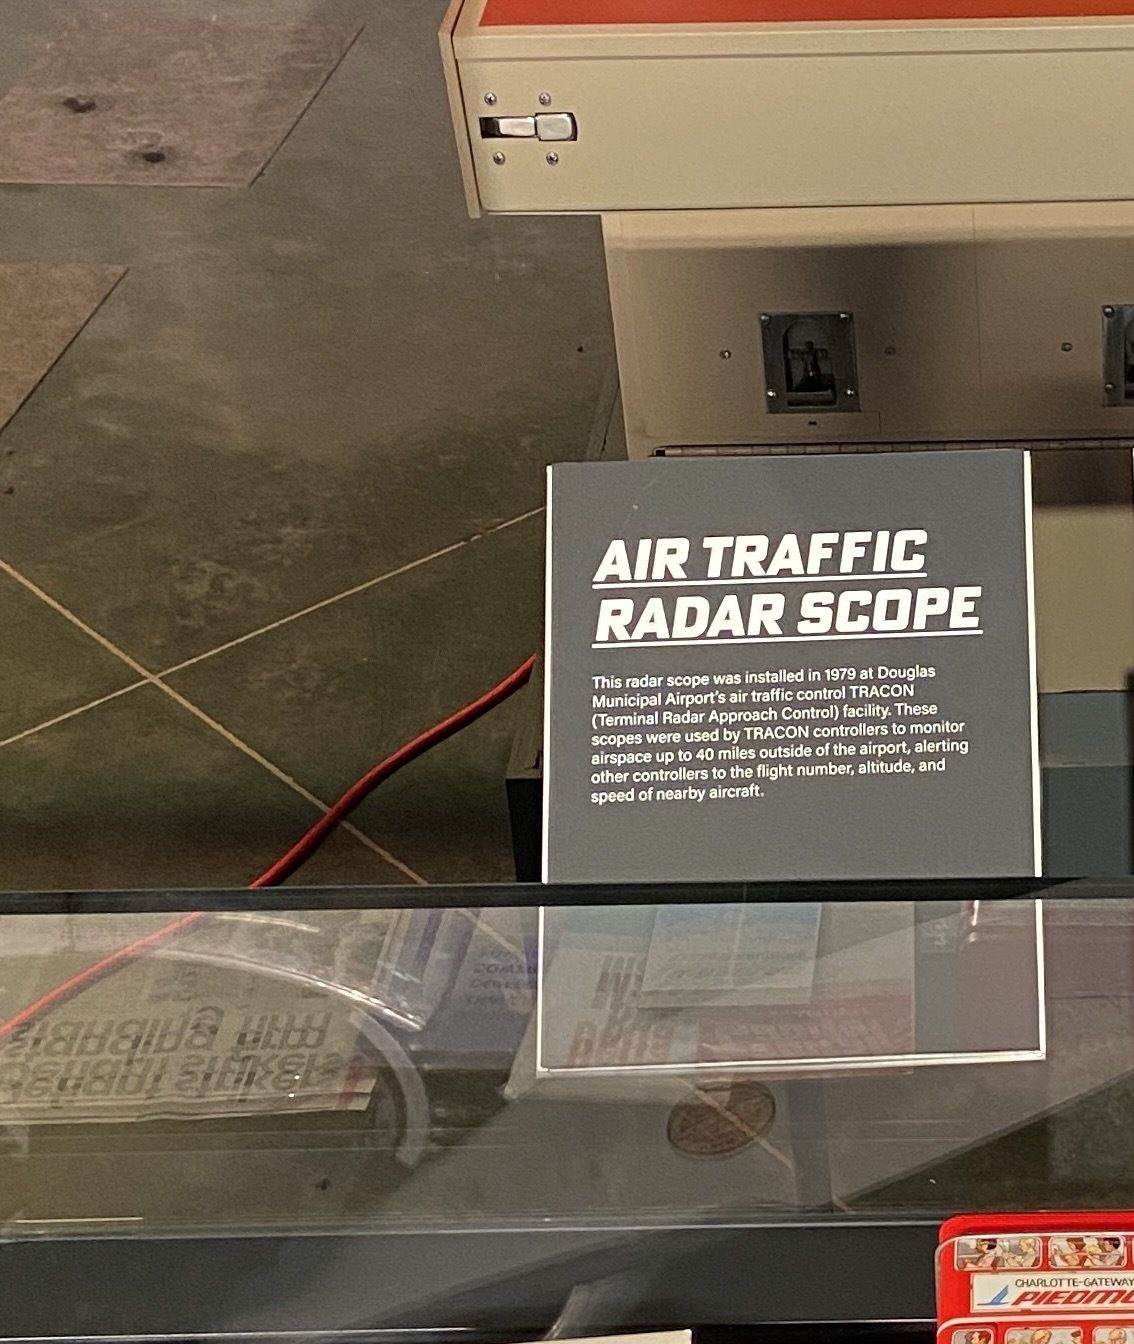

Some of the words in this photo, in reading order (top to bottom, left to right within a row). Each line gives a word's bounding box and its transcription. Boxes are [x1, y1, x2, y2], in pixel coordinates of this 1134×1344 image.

[592, 537, 690, 583] AIR
[702, 529, 928, 579] TRAFFIC
[595, 589, 785, 643] RADAR
[798, 586, 982, 636] SCOPE
[591, 674, 622, 689] This
[625, 673, 664, 688] radar
[666, 675, 710, 688] scope
[712, 673, 741, 685] was
[745, 668, 804, 684] installed
[808, 668, 821, 681] in
[824, 667, 856, 681] 1979
[859, 667, 874, 680] at
[877, 664, 936, 681] Douglas
[592, 692, 661, 709] Municipal
[664, 689, 726, 708] Airport's
[728, 689, 748, 703] air
[750, 687, 793, 702] traffic
[796, 685, 846, 701] control
[849, 683, 914, 698] TRACON
[591, 710, 658, 730] (Terminal
[662, 709, 705, 724] Radar
[708, 706, 778, 725] Approach
[781, 704, 839, 721] Control)
[842, 703, 892, 720] facility.
[893, 702, 938, 716] These
[1015, 1277, 1134, 1288] CHARLOTTE-GATEWAY
